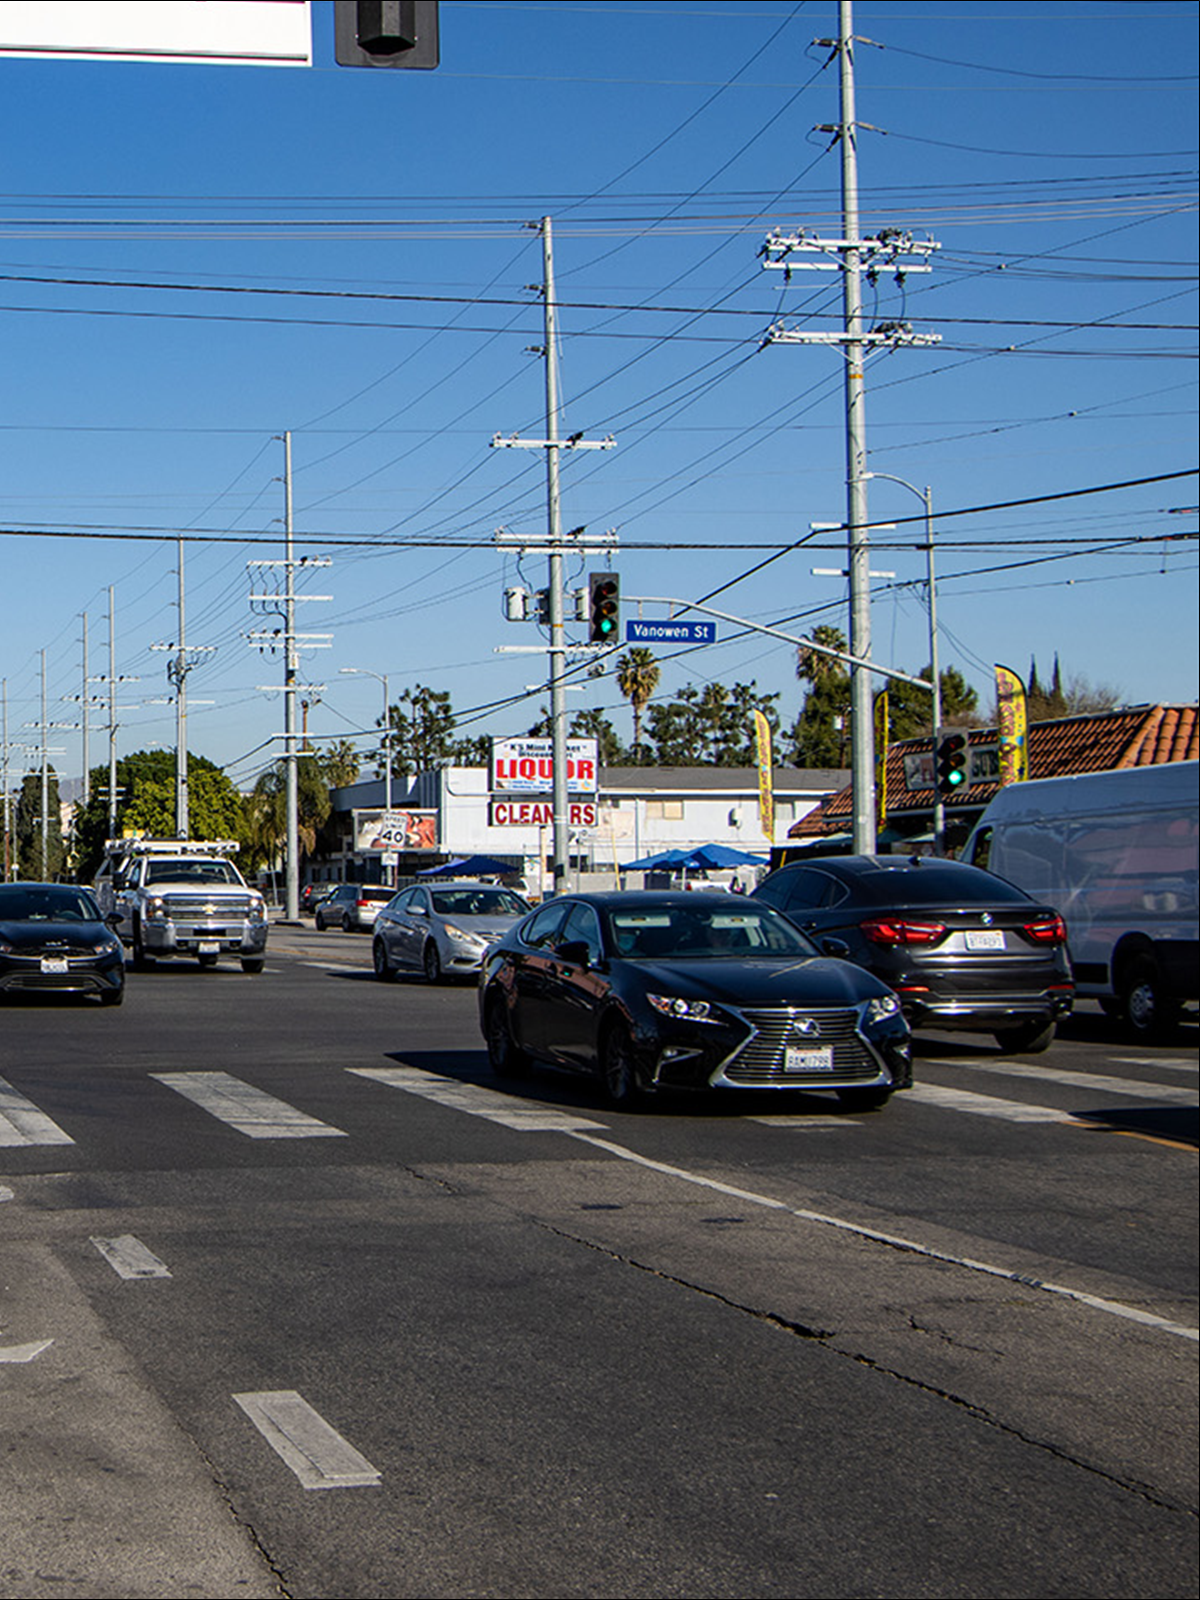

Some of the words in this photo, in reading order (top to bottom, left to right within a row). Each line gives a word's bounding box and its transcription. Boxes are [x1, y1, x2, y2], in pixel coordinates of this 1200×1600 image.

[633, 624, 689, 637] Vanowen
[694, 625, 709, 638] St
[495, 804, 594, 824] CLEANRS
[382, 830, 404, 843] 40
